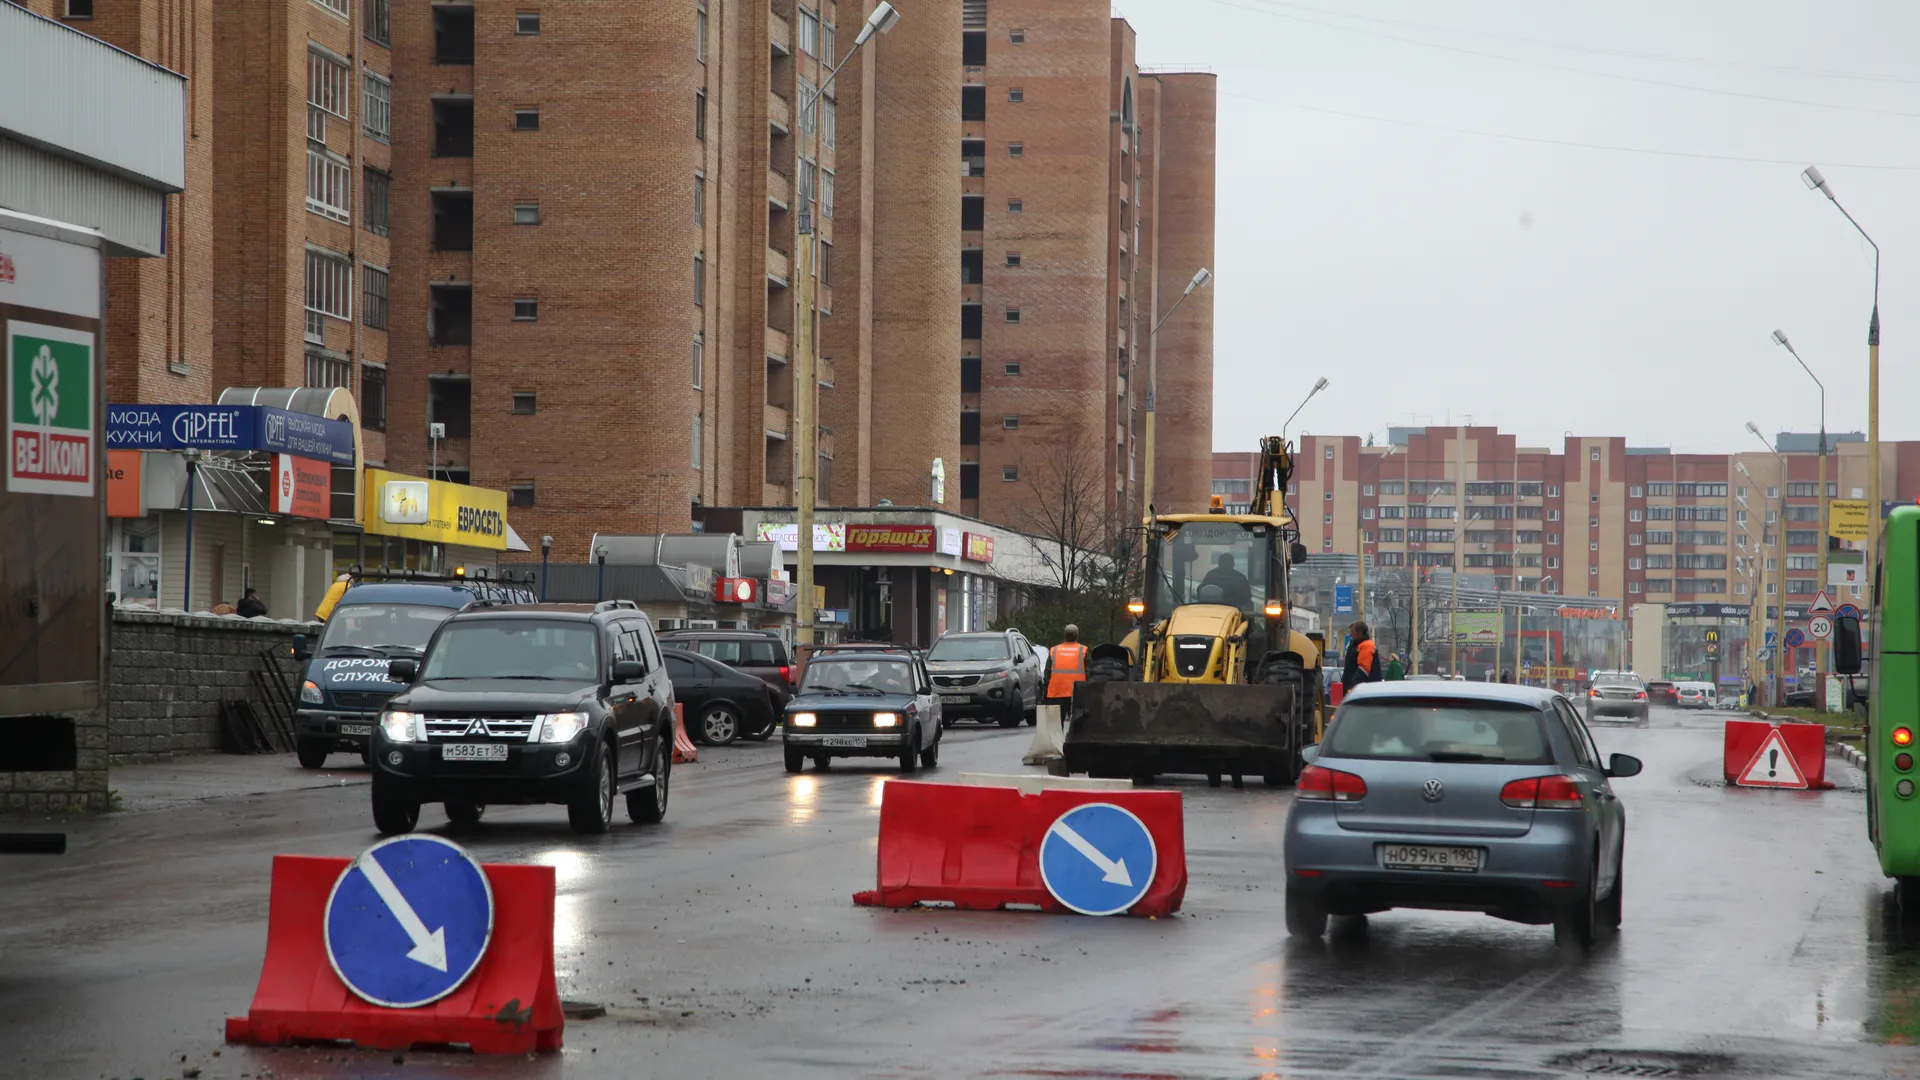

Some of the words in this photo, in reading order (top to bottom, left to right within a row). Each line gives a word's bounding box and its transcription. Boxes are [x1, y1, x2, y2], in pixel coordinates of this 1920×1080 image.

[110, 412, 161, 426] МОДА
[287, 417, 312, 434] ВЫСОКАЯ
[312, 421, 326, 437] МОДА
[106, 430, 161, 444] КУХНИ
[287, 436, 298, 450] ДЛЯ
[298, 438, 315, 453] ВАШЕЙ
[315, 441, 332, 456] КУХНИ
[457, 505, 503, 537] ЕВРОСЕТЬ
[847, 528, 932, 548] Горящих
[1813, 623, 1828, 633] 20
[324, 659, 420, 671] ДОРОЖ
[332, 672, 405, 685] СЛУЖБ
[446, 745, 490, 757] М583ЕТ
[493, 745, 505, 754] 50
[1388, 847, 1448, 864] Н099КВ
[1451, 848, 1474, 861] 190
